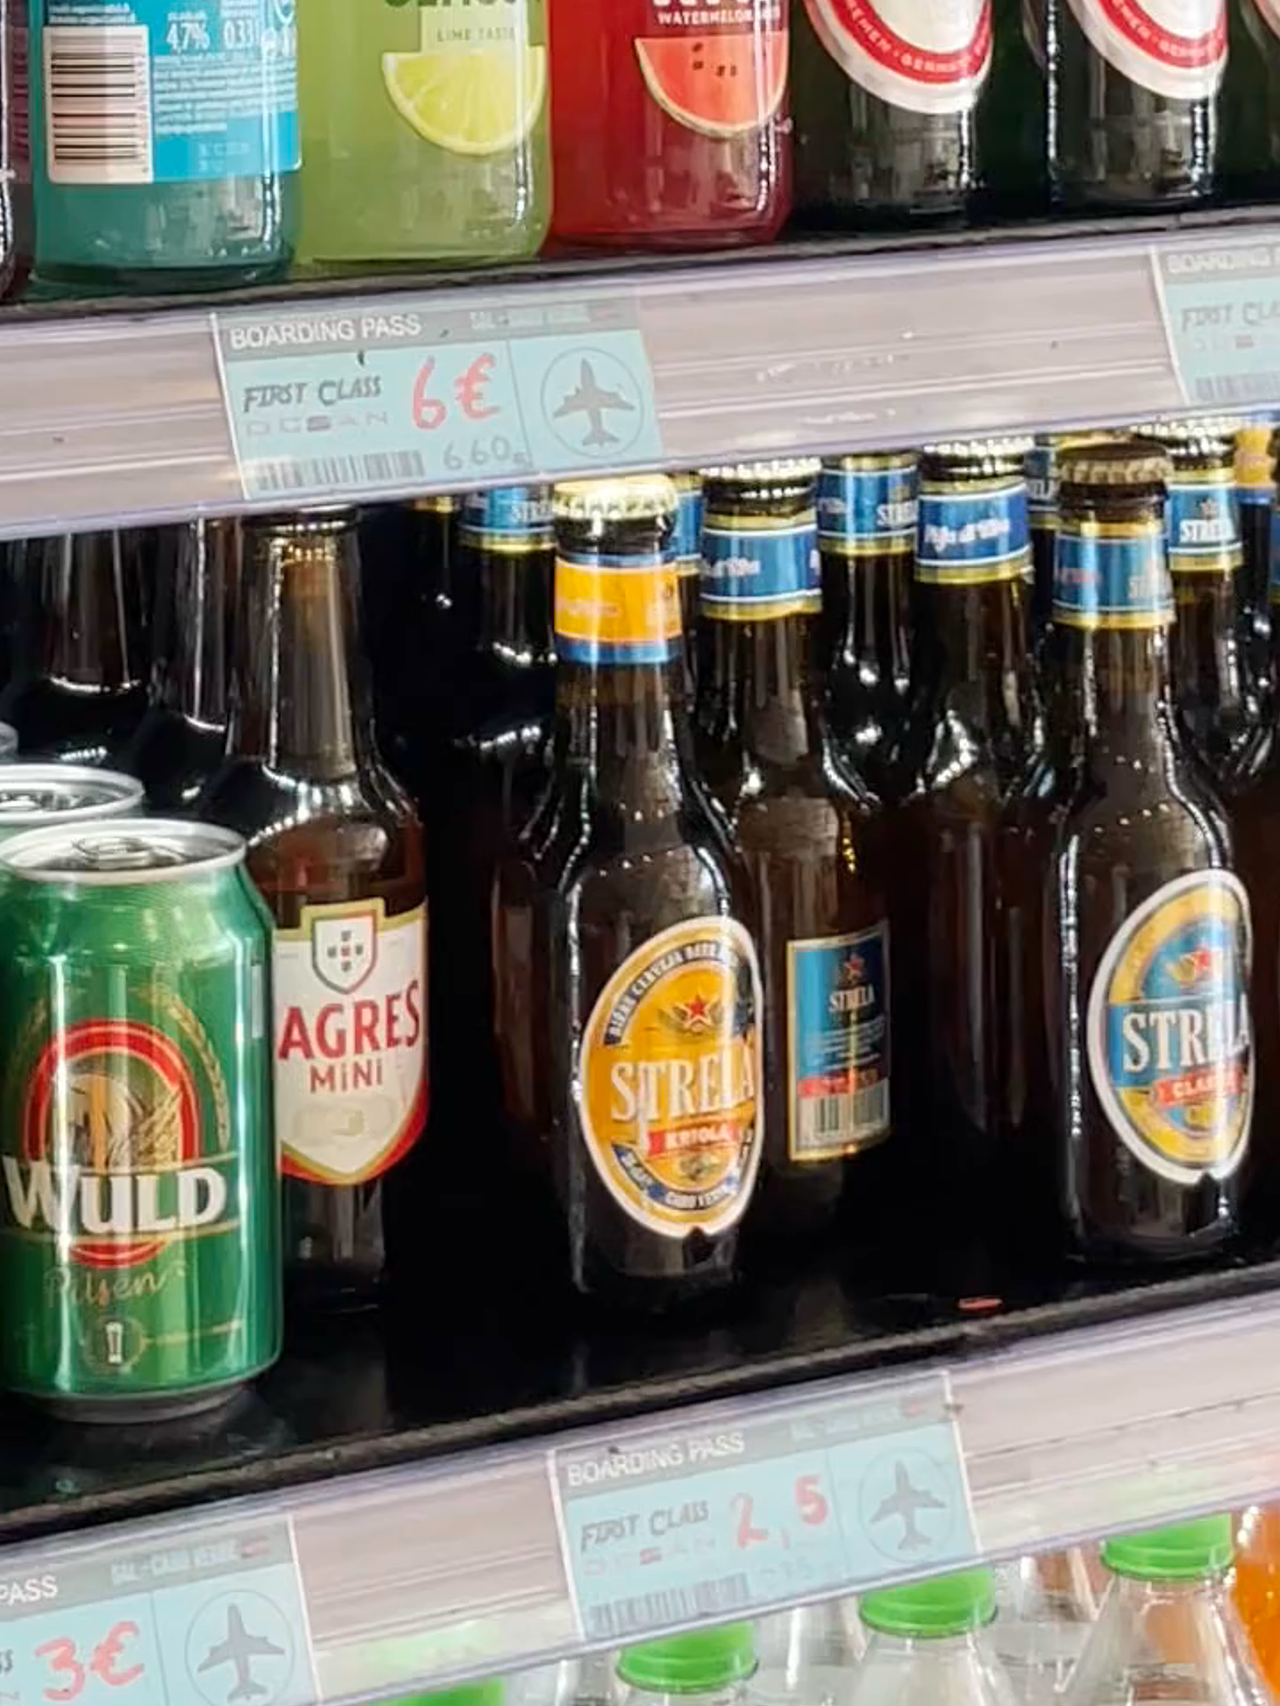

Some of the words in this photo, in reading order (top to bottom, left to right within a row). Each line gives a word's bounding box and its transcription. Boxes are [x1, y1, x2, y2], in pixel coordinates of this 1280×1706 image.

[230, 320, 355, 351] BOARDING
[362, 314, 422, 339] PASS
[243, 383, 308, 413] FIRST
[319, 376, 382, 406] CLASS
[279, 980, 420, 1061] AGRES
[3, 1155, 225, 1234] WULD
[567, 1443, 683, 1488] BOARDING
[688, 1431, 745, 1459] PASS
[581, 1514, 638, 1554] FIRST
[648, 1500, 710, 1537] CLASS
